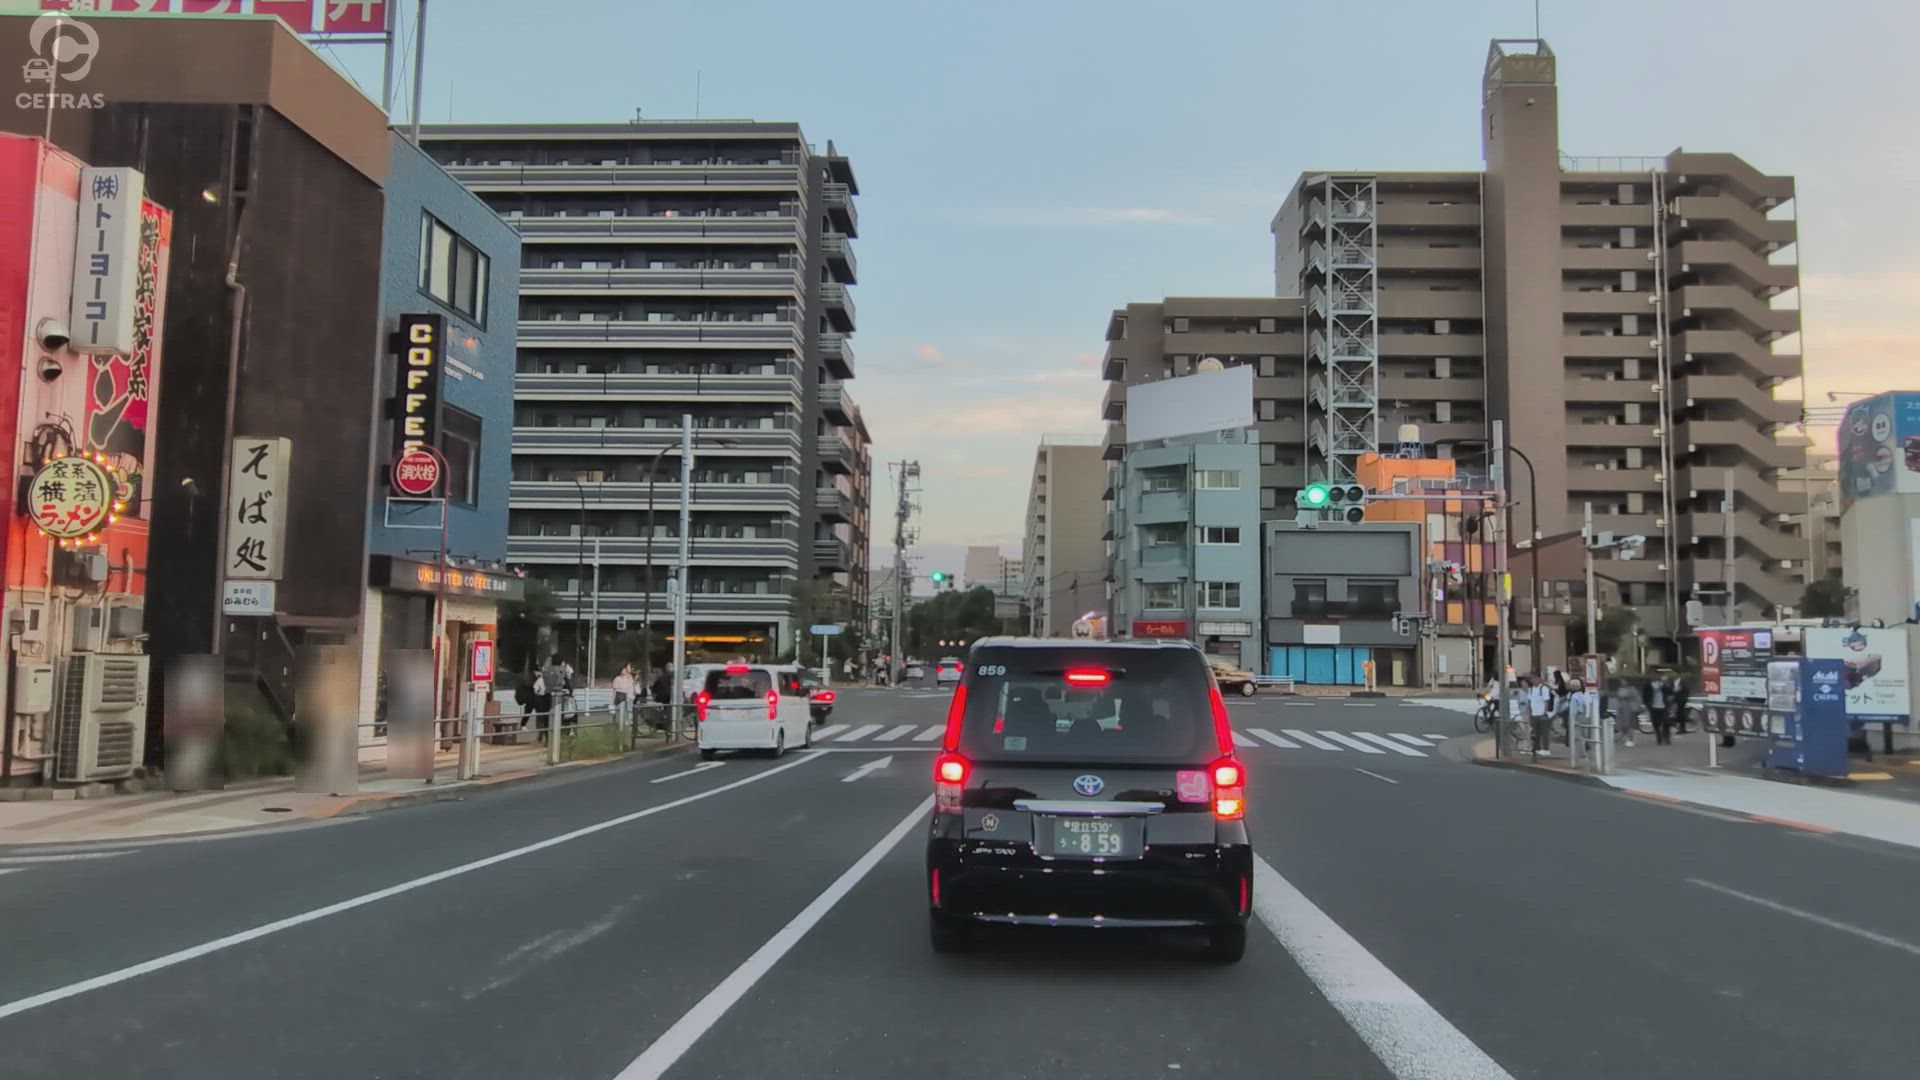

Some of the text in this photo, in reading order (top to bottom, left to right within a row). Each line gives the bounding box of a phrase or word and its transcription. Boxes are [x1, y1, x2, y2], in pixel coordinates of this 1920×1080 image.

[403, 323, 433, 459] COFFEE
[52, 460, 86, 480] 家系
[401, 464, 435, 481] 消火栓
[233, 443, 273, 572] そば処
[39, 504, 101, 532] ラーメン
[464, 575, 491, 591] COFFEE
[493, 578, 507, 592] BAR
[978, 665, 1006, 676] 859
[1812, 670, 1838, 681] Asahi
[1846, 692, 1873, 705] ット
